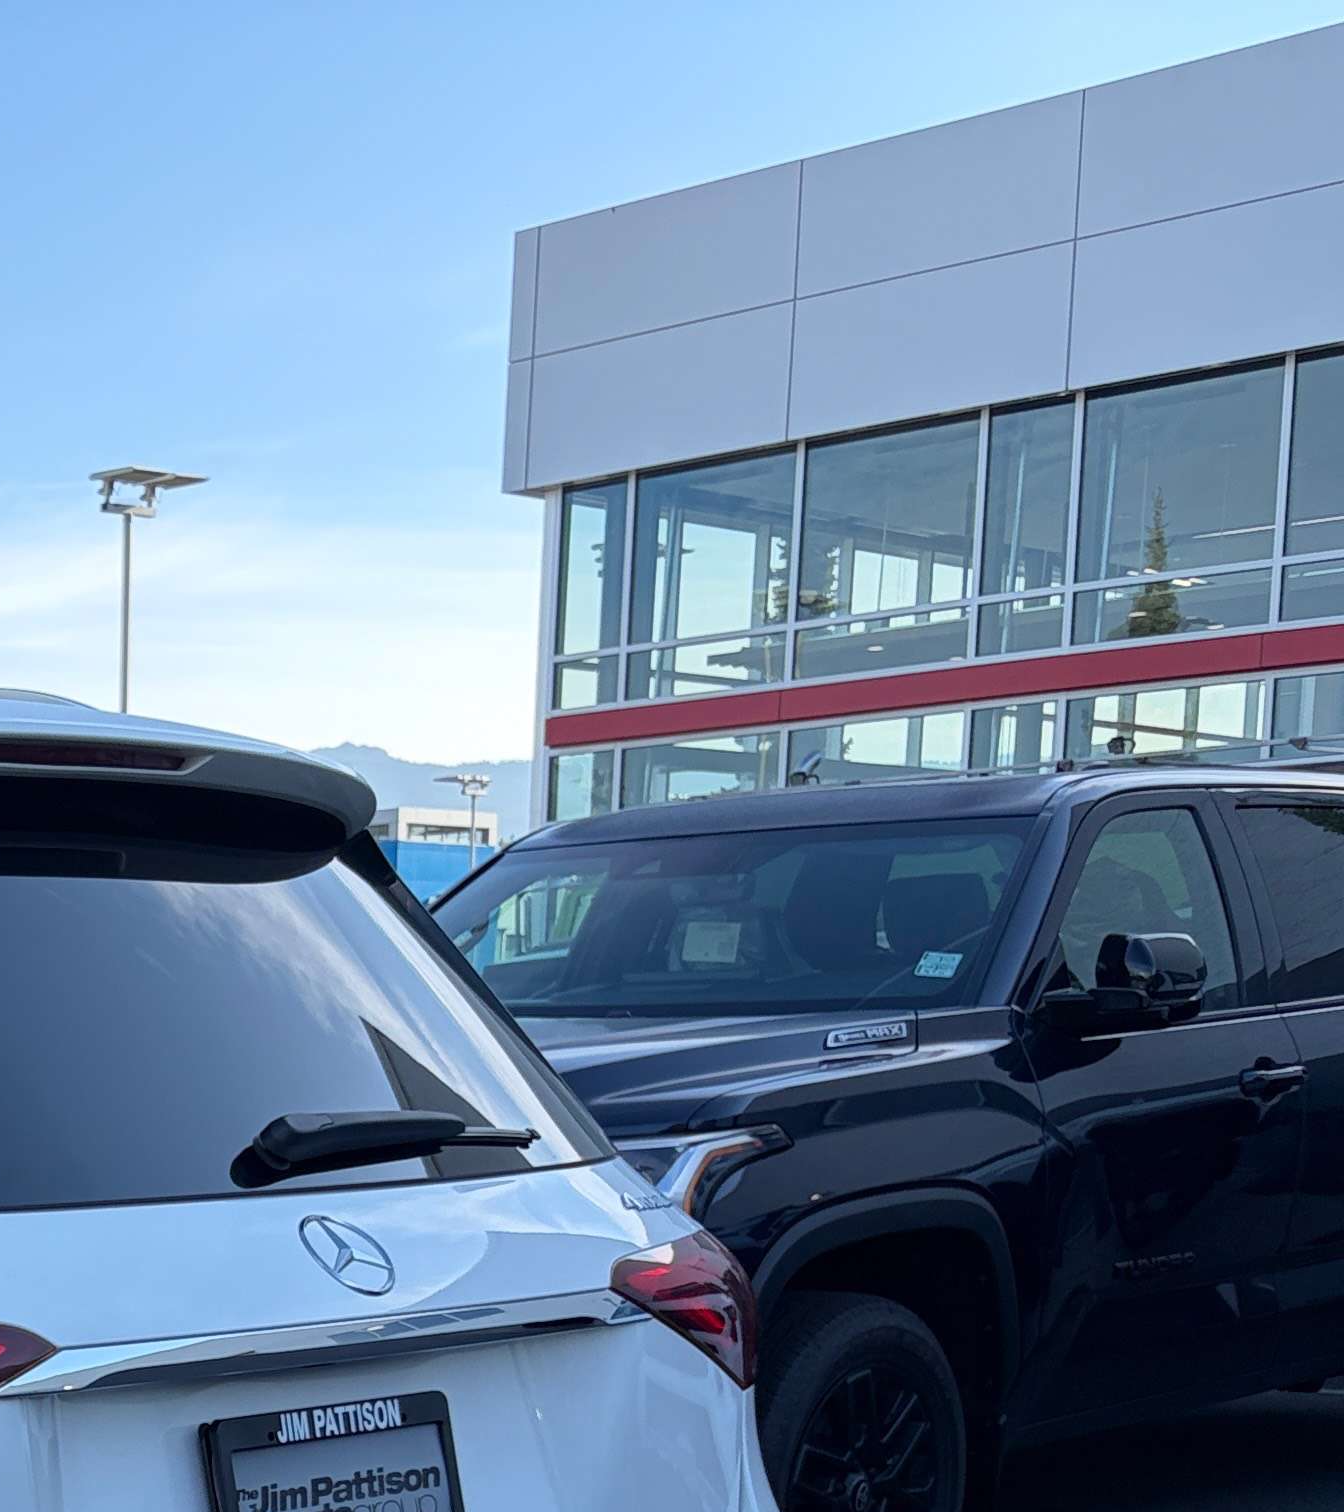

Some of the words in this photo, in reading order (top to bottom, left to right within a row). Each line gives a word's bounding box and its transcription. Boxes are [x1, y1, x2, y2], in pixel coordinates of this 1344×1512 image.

[276, 1408, 310, 1443] JIM
[314, 1400, 402, 1439] PATTISON
[311, 1465, 440, 1504] Pattison
